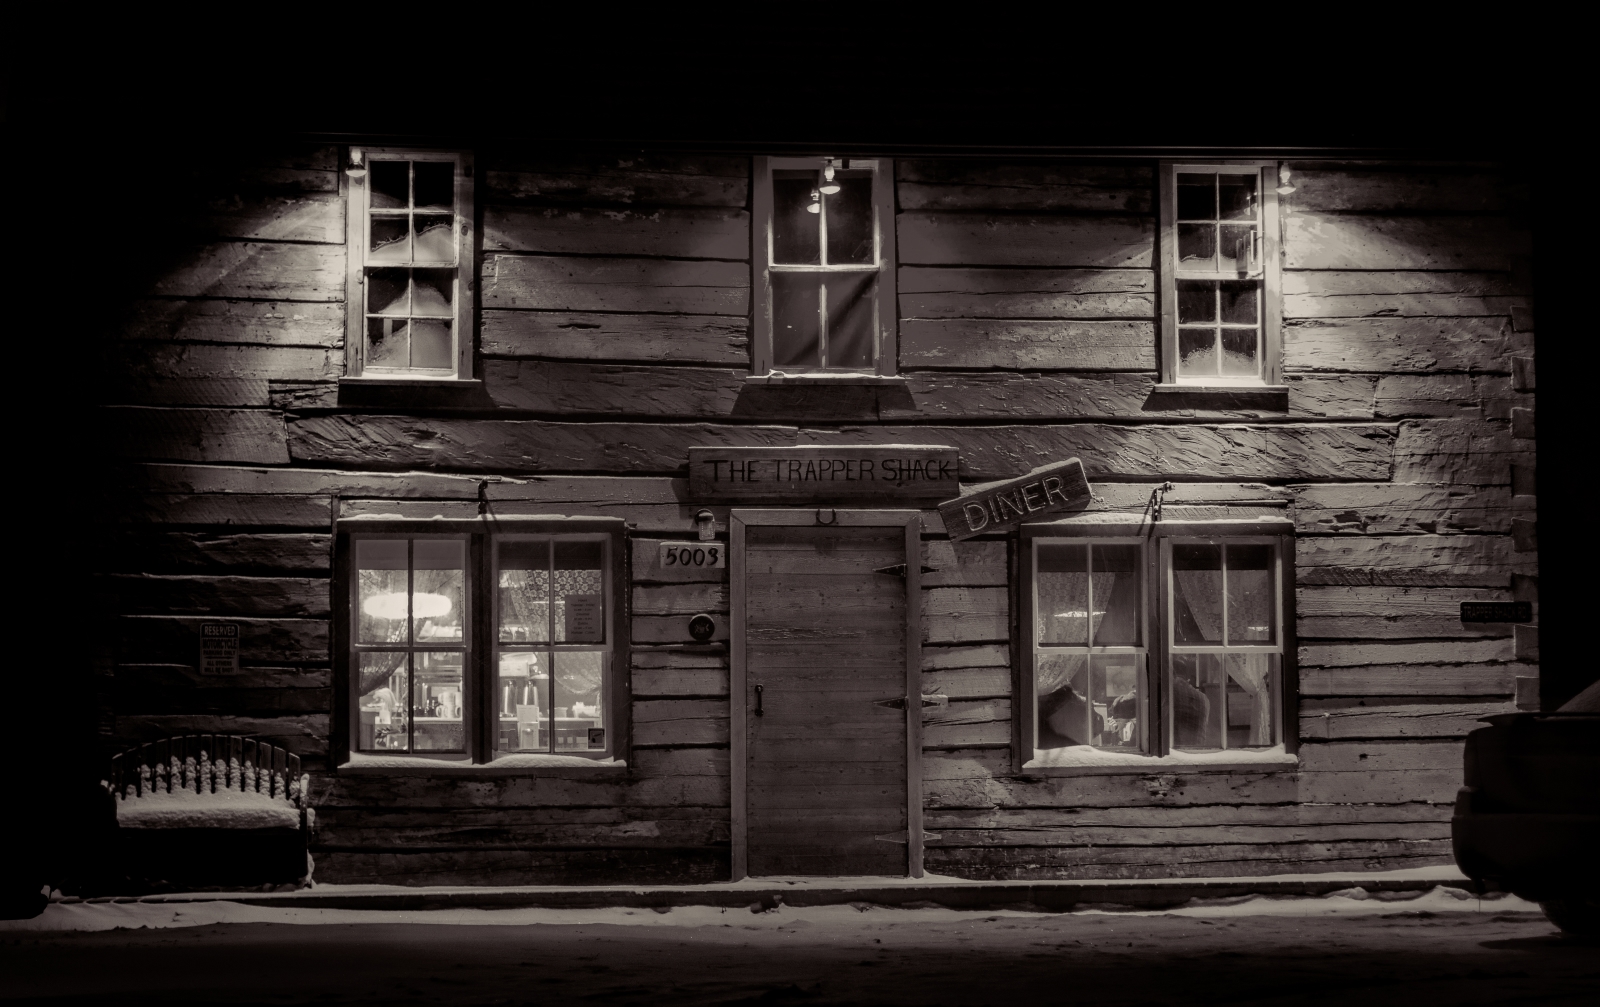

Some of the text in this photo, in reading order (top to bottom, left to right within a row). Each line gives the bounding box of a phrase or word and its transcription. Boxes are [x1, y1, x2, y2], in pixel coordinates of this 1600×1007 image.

[702, 458, 952, 482] THE TRAPPER SHACK
[962, 476, 1070, 532] DINER
[665, 546, 719, 566] 5003
[1463, 605, 1493, 619] TRAPPER
[1494, 606, 1516, 619] SHACK
[204, 626, 235, 636] RESERVED
[203, 638, 237, 649] MOTORCYCLE
